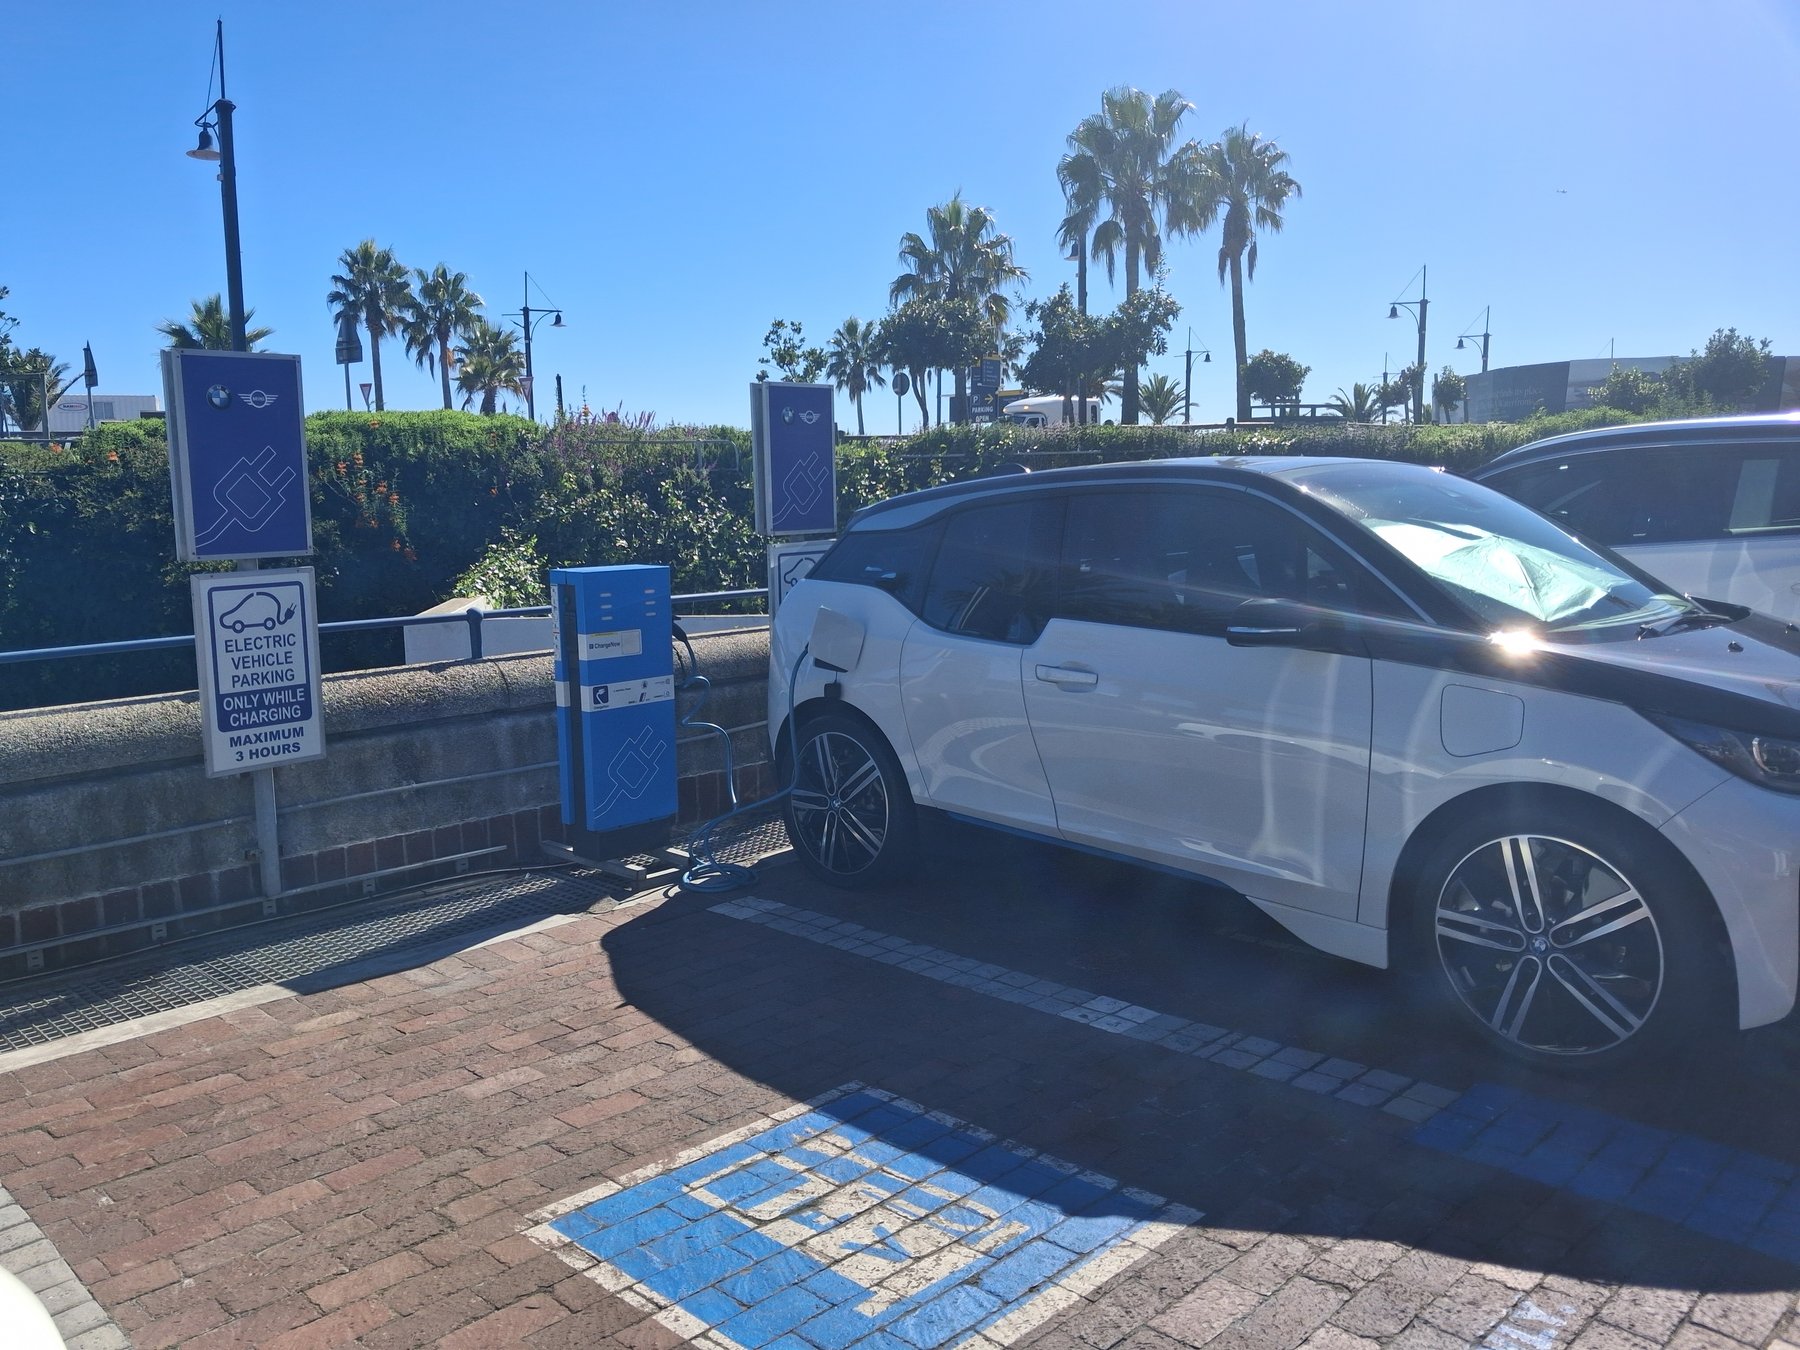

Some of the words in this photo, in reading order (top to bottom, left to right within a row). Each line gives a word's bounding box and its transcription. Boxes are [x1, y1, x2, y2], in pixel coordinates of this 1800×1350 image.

[224, 633, 297, 653] ELECTRIC
[594, 641, 620, 649] ChargeNow
[231, 651, 293, 670] VEHICLE
[231, 668, 295, 688] PARKING
[223, 693, 260, 711] ONLY
[263, 688, 305, 706] WHILE
[230, 705, 301, 727] CHARGING
[229, 726, 304, 748] MAXIMUM
[235, 751, 244, 762] 3
[249, 742, 301, 760] HOURS
